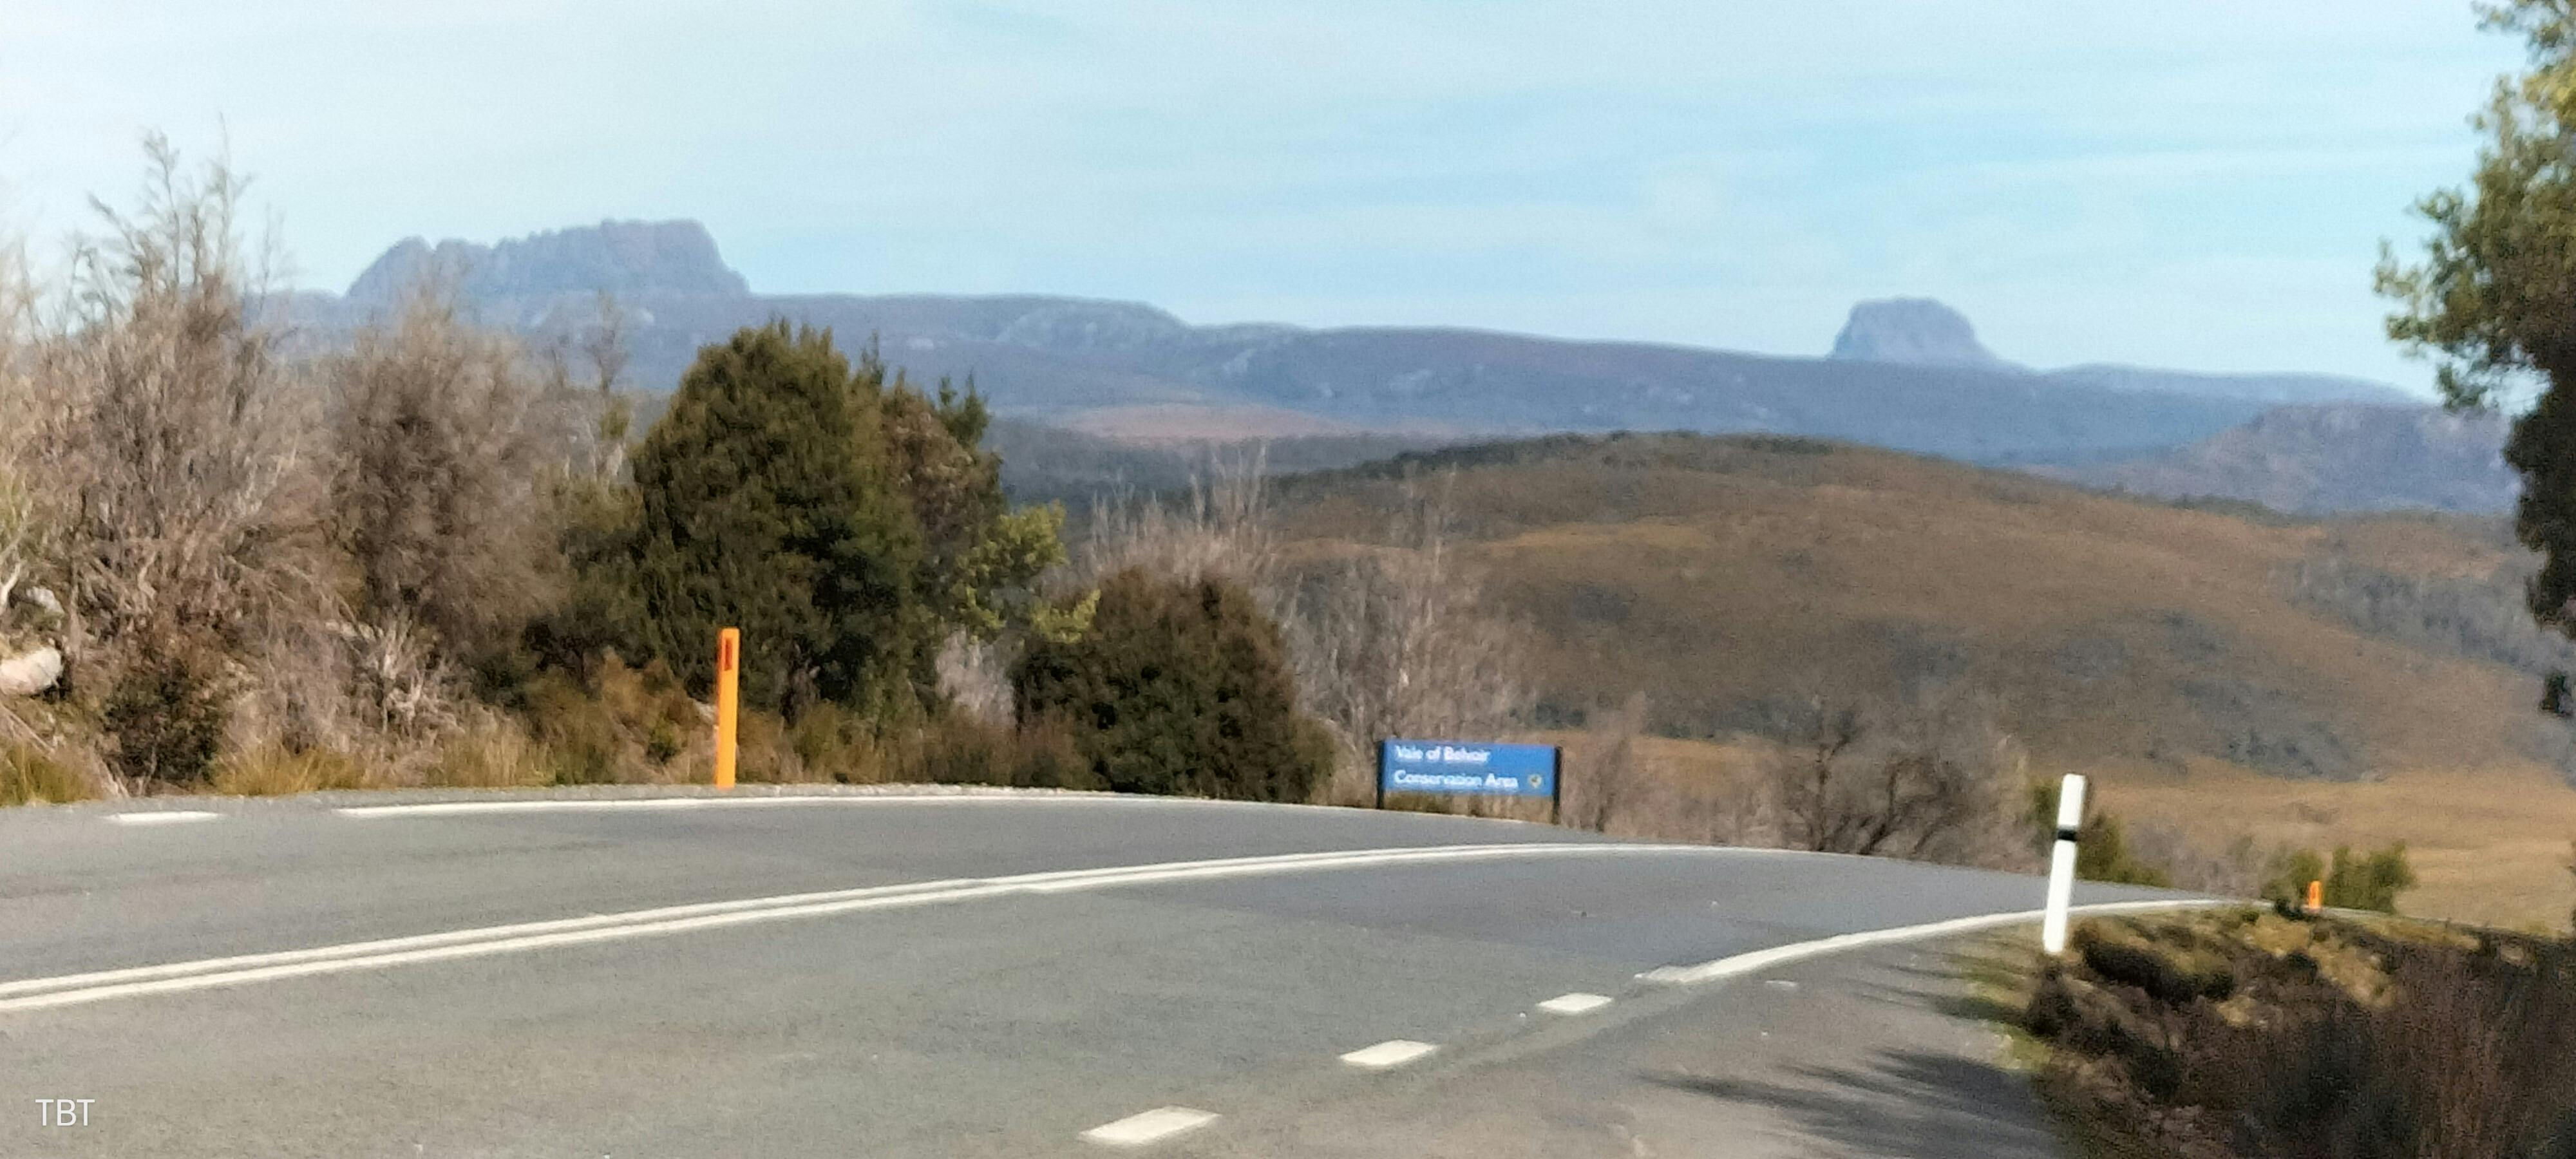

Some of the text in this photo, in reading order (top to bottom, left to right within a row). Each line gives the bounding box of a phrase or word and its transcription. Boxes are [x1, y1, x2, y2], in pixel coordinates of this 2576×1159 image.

[1394, 745, 1490, 763] Vale of Belvoir
[1394, 769, 1519, 788] Conservation Area
